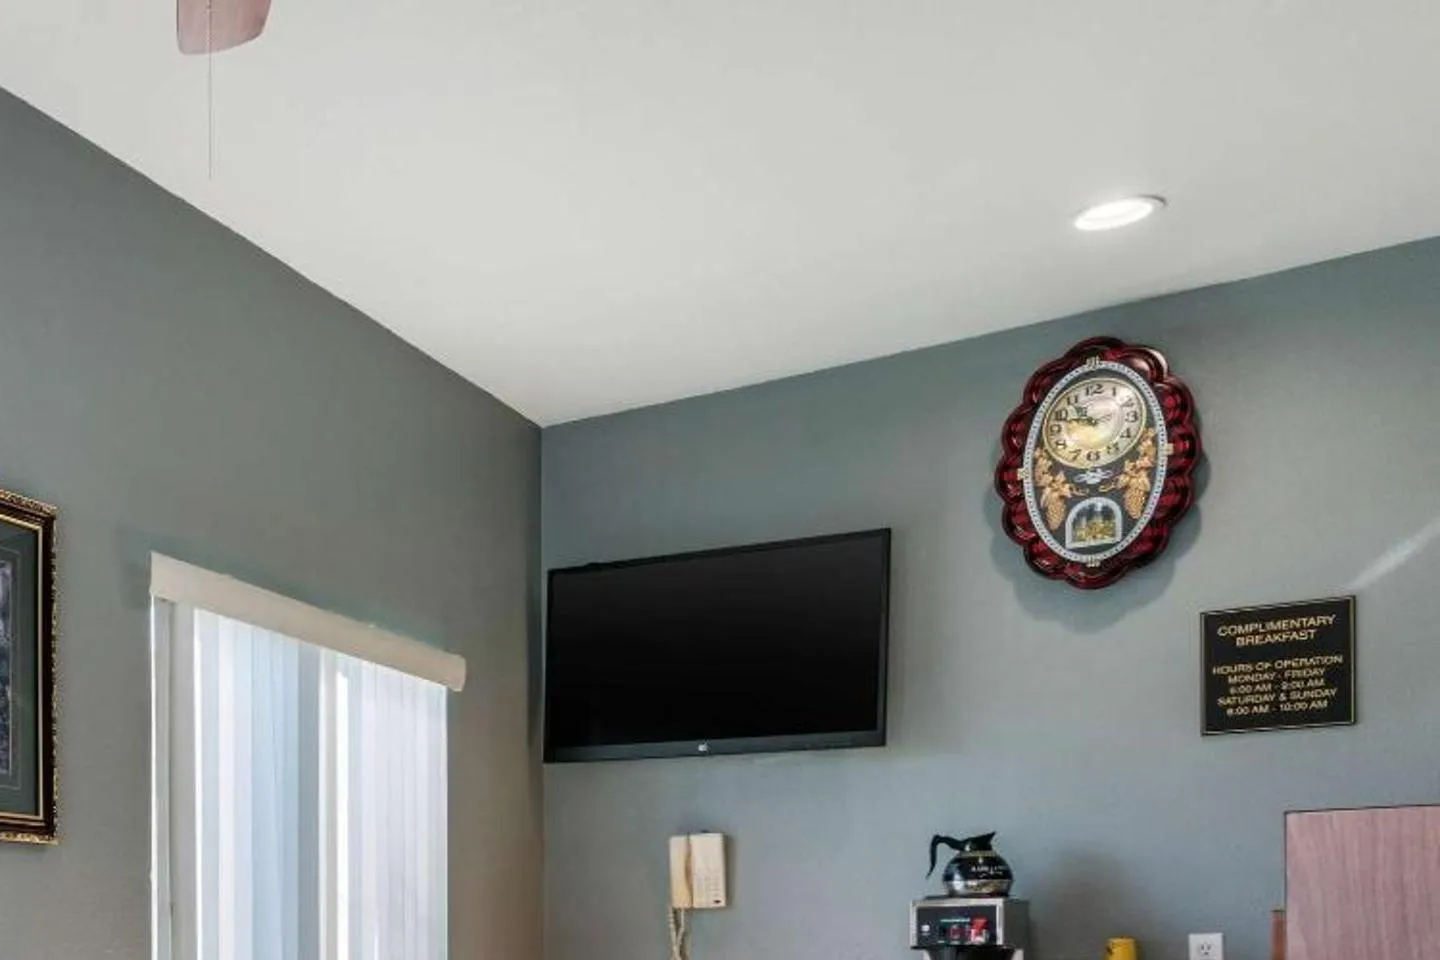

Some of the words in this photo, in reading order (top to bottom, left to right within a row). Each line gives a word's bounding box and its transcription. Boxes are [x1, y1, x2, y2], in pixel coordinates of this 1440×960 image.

[1085, 384, 1104, 396] 12
[1055, 409, 1069, 421] 10
[1125, 410, 1138, 422] 3
[1120, 428, 1131, 438] 4
[1217, 614, 1336, 637] COMPLIMENTARY
[1235, 629, 1316, 647] BREAKFAST
[1212, 662, 1253, 675] HOURS
[1255, 661, 1272, 671] OF
[1274, 654, 1343, 669] OPERATION
[1228, 672, 1276, 684] MONDAY
[1284, 668, 1325, 679] FRIDAY
[1254, 682, 1272, 693] AM
[1307, 677, 1325, 687] AM
[1217, 693, 1276, 706] SATURDAY
[1278, 692, 1288, 702] &
[1289, 688, 1338, 700] SUNDAY
[1251, 703, 1270, 714] AM
[1309, 699, 1328, 709] AM
